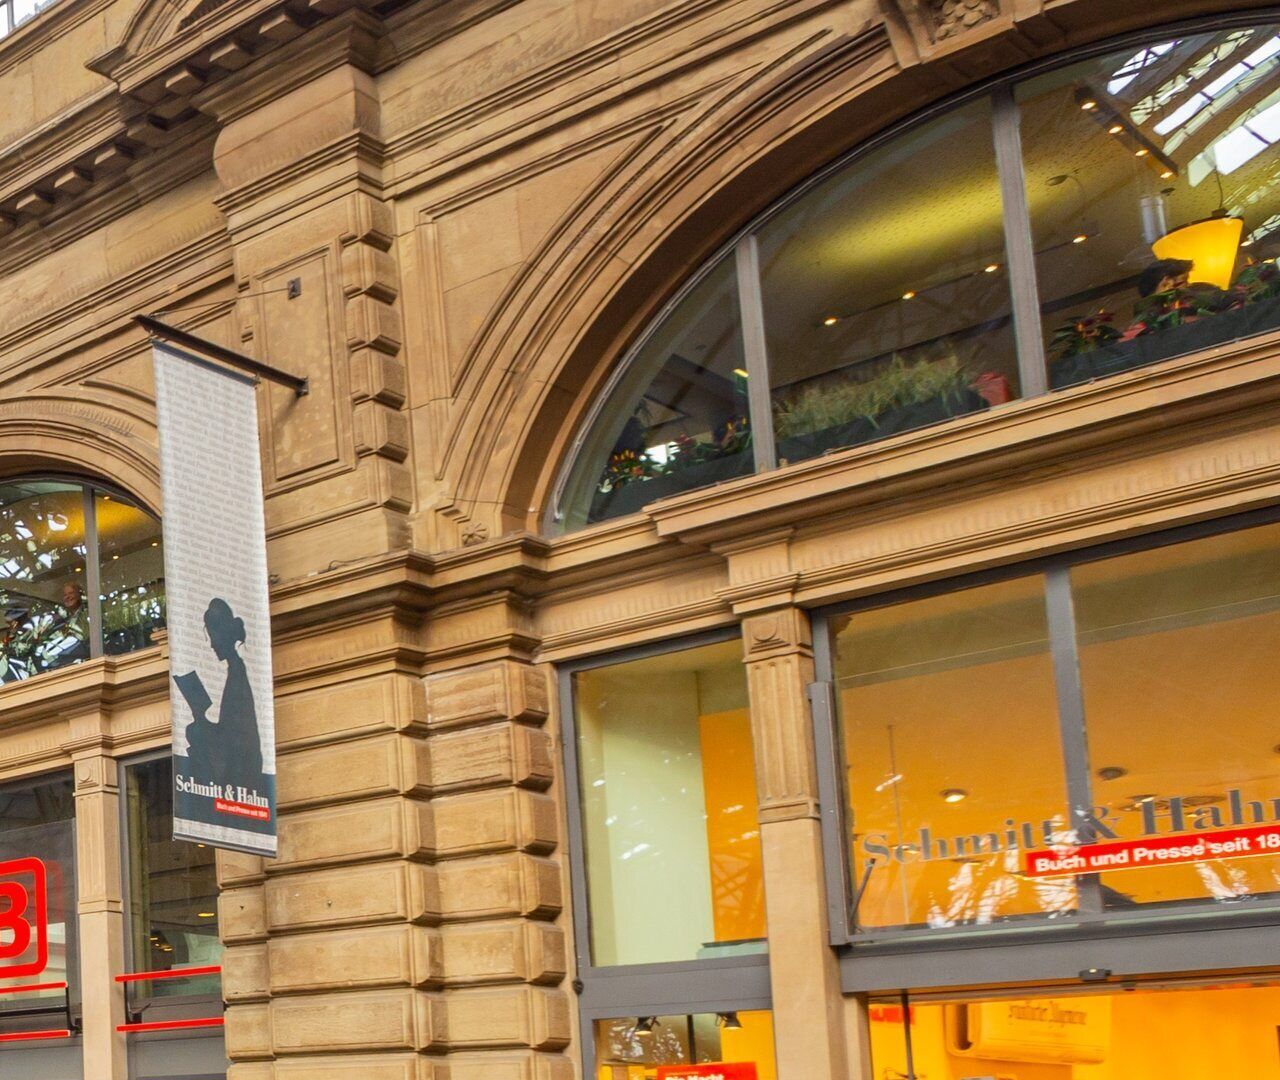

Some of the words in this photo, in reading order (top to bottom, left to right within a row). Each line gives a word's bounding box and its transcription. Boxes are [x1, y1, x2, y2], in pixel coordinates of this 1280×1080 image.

[175, 774, 224, 799] Schmitt
[224, 784, 236, 802] &
[236, 786, 269, 809] Hahn
[862, 815, 1060, 870] Schmitt
[1075, 804, 1122, 846] &
[1035, 852, 1086, 873] Buch
[1090, 848, 1129, 867] und
[1132, 840, 1205, 863] Presse
[1209, 836, 1252, 856] seit
